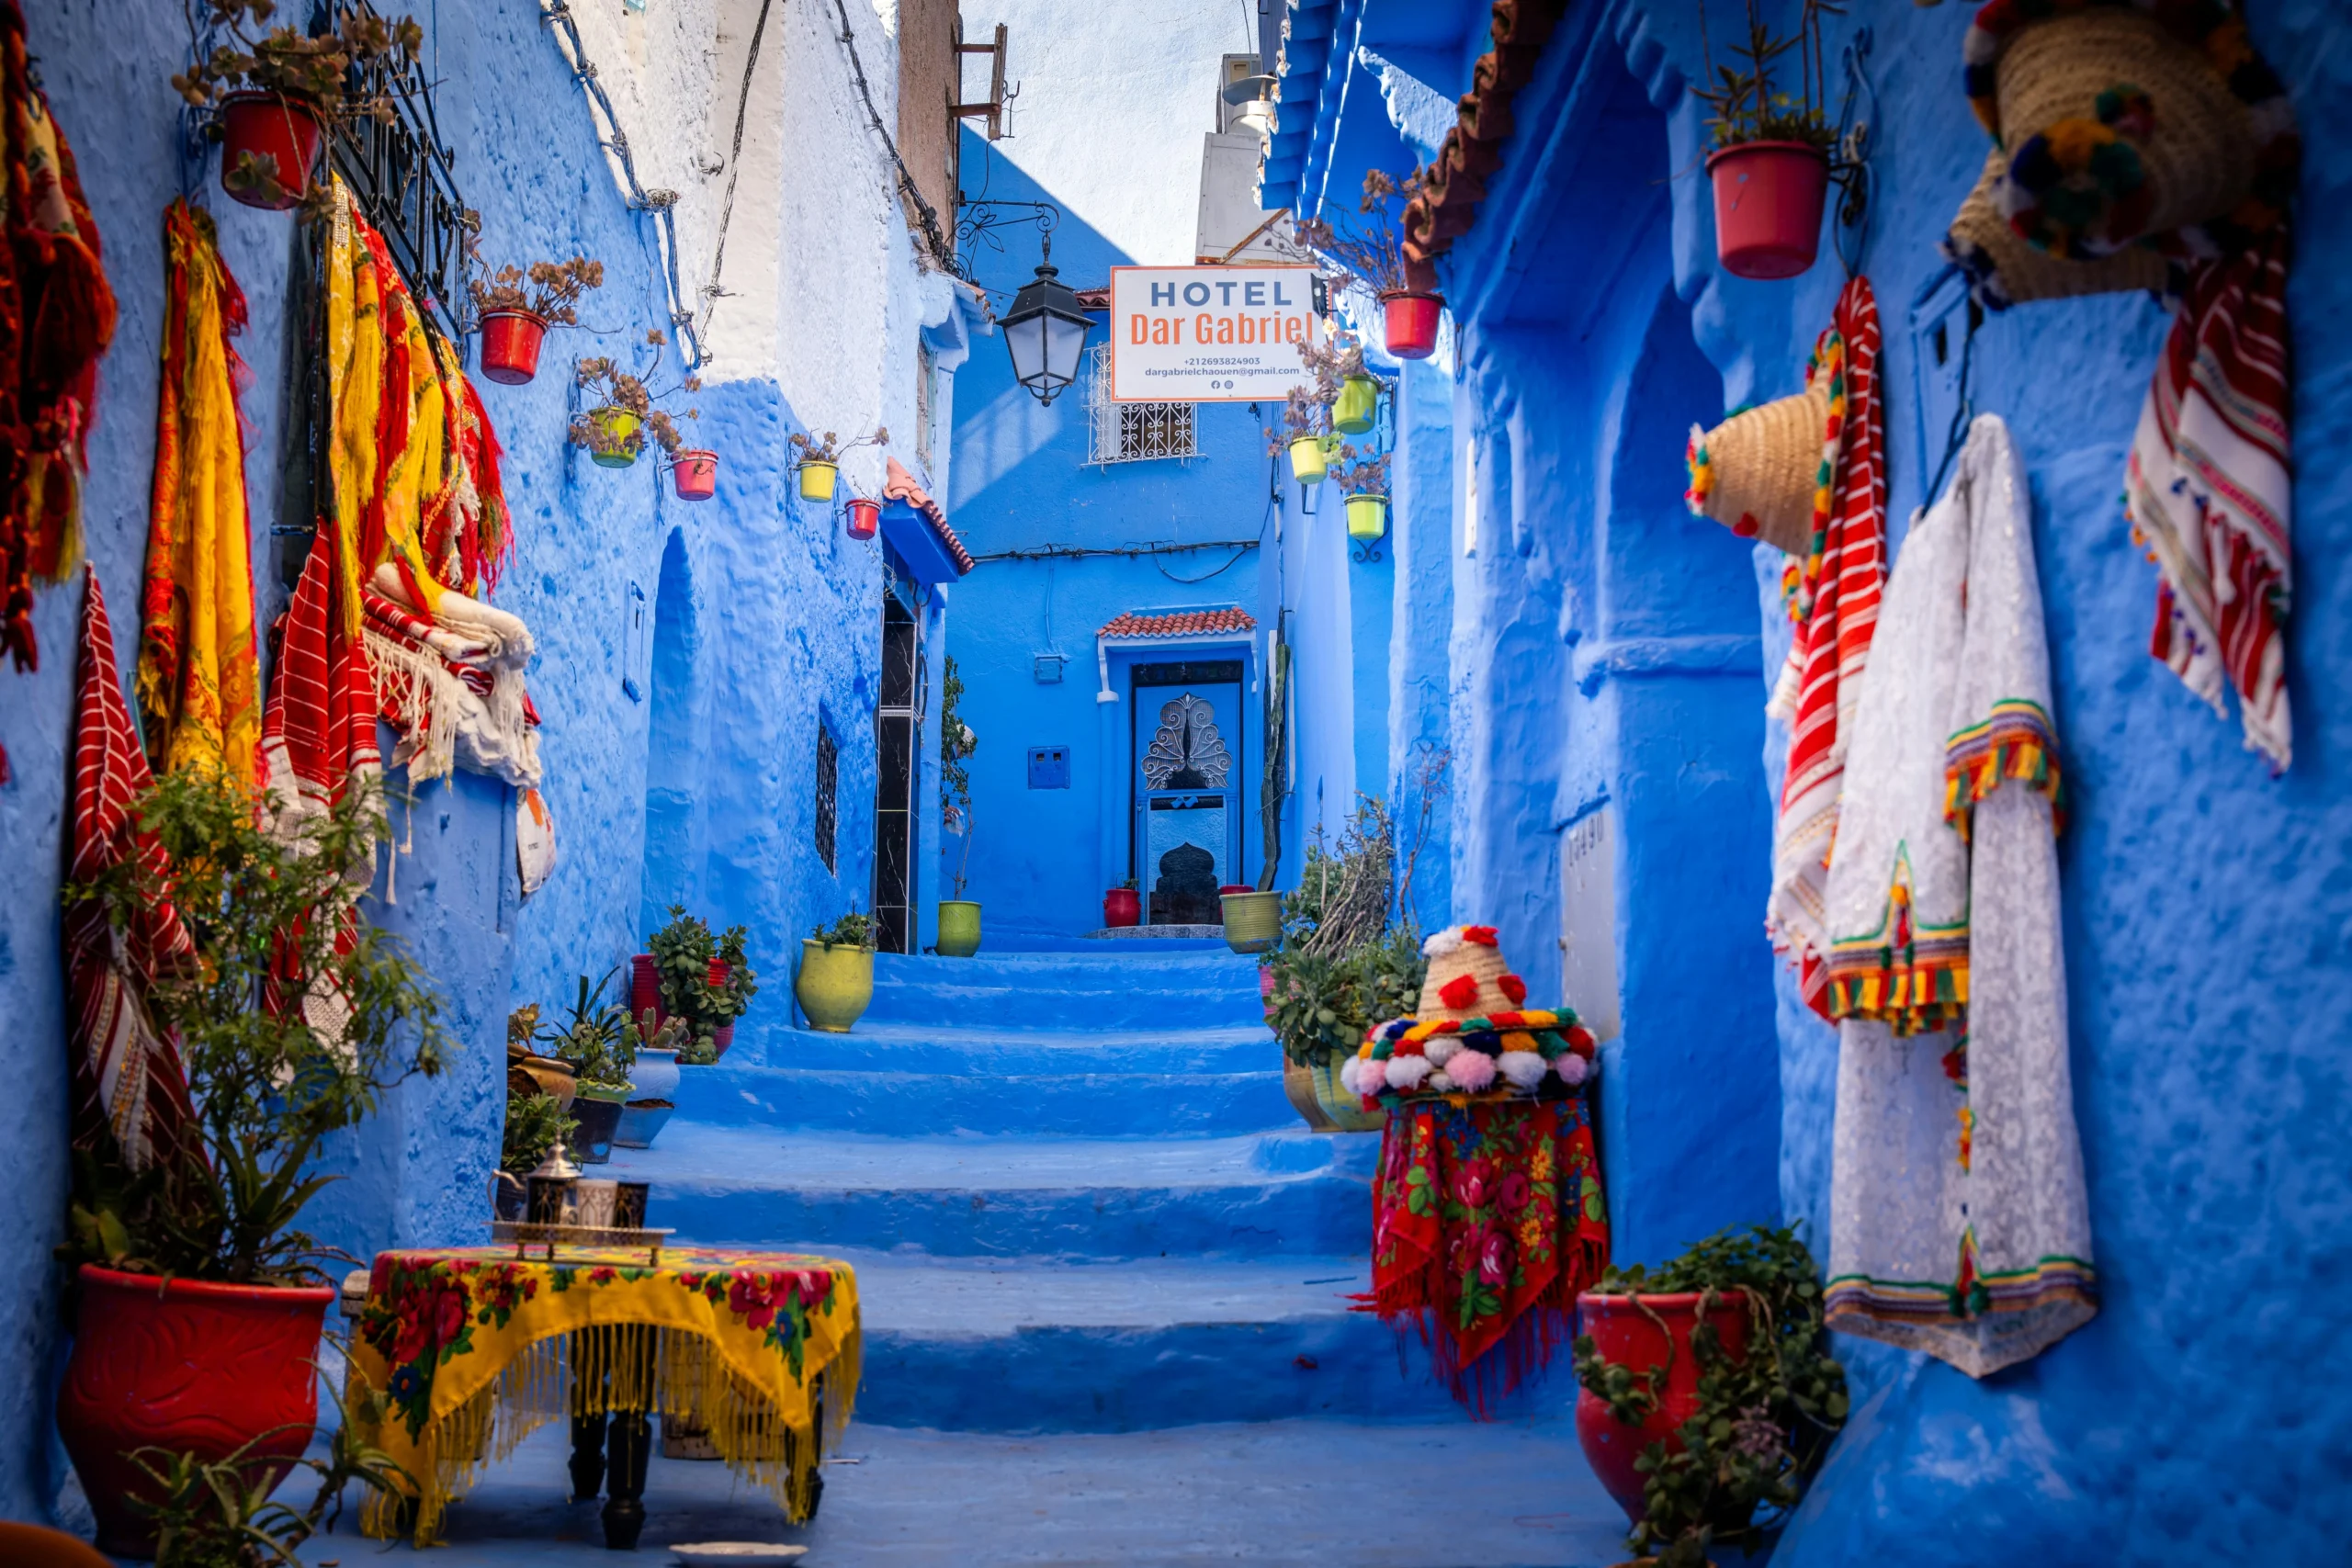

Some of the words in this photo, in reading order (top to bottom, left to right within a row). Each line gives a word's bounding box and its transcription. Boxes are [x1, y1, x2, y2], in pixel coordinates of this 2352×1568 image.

[1151, 282, 1292, 307] HOTEL
[1131, 313, 1185, 345] Dar
[1195, 310, 1313, 344] Gabriel
[1184, 357, 1261, 366] +212693824903
[1145, 367, 1300, 378] dargabrielchaouen@gmail.com
